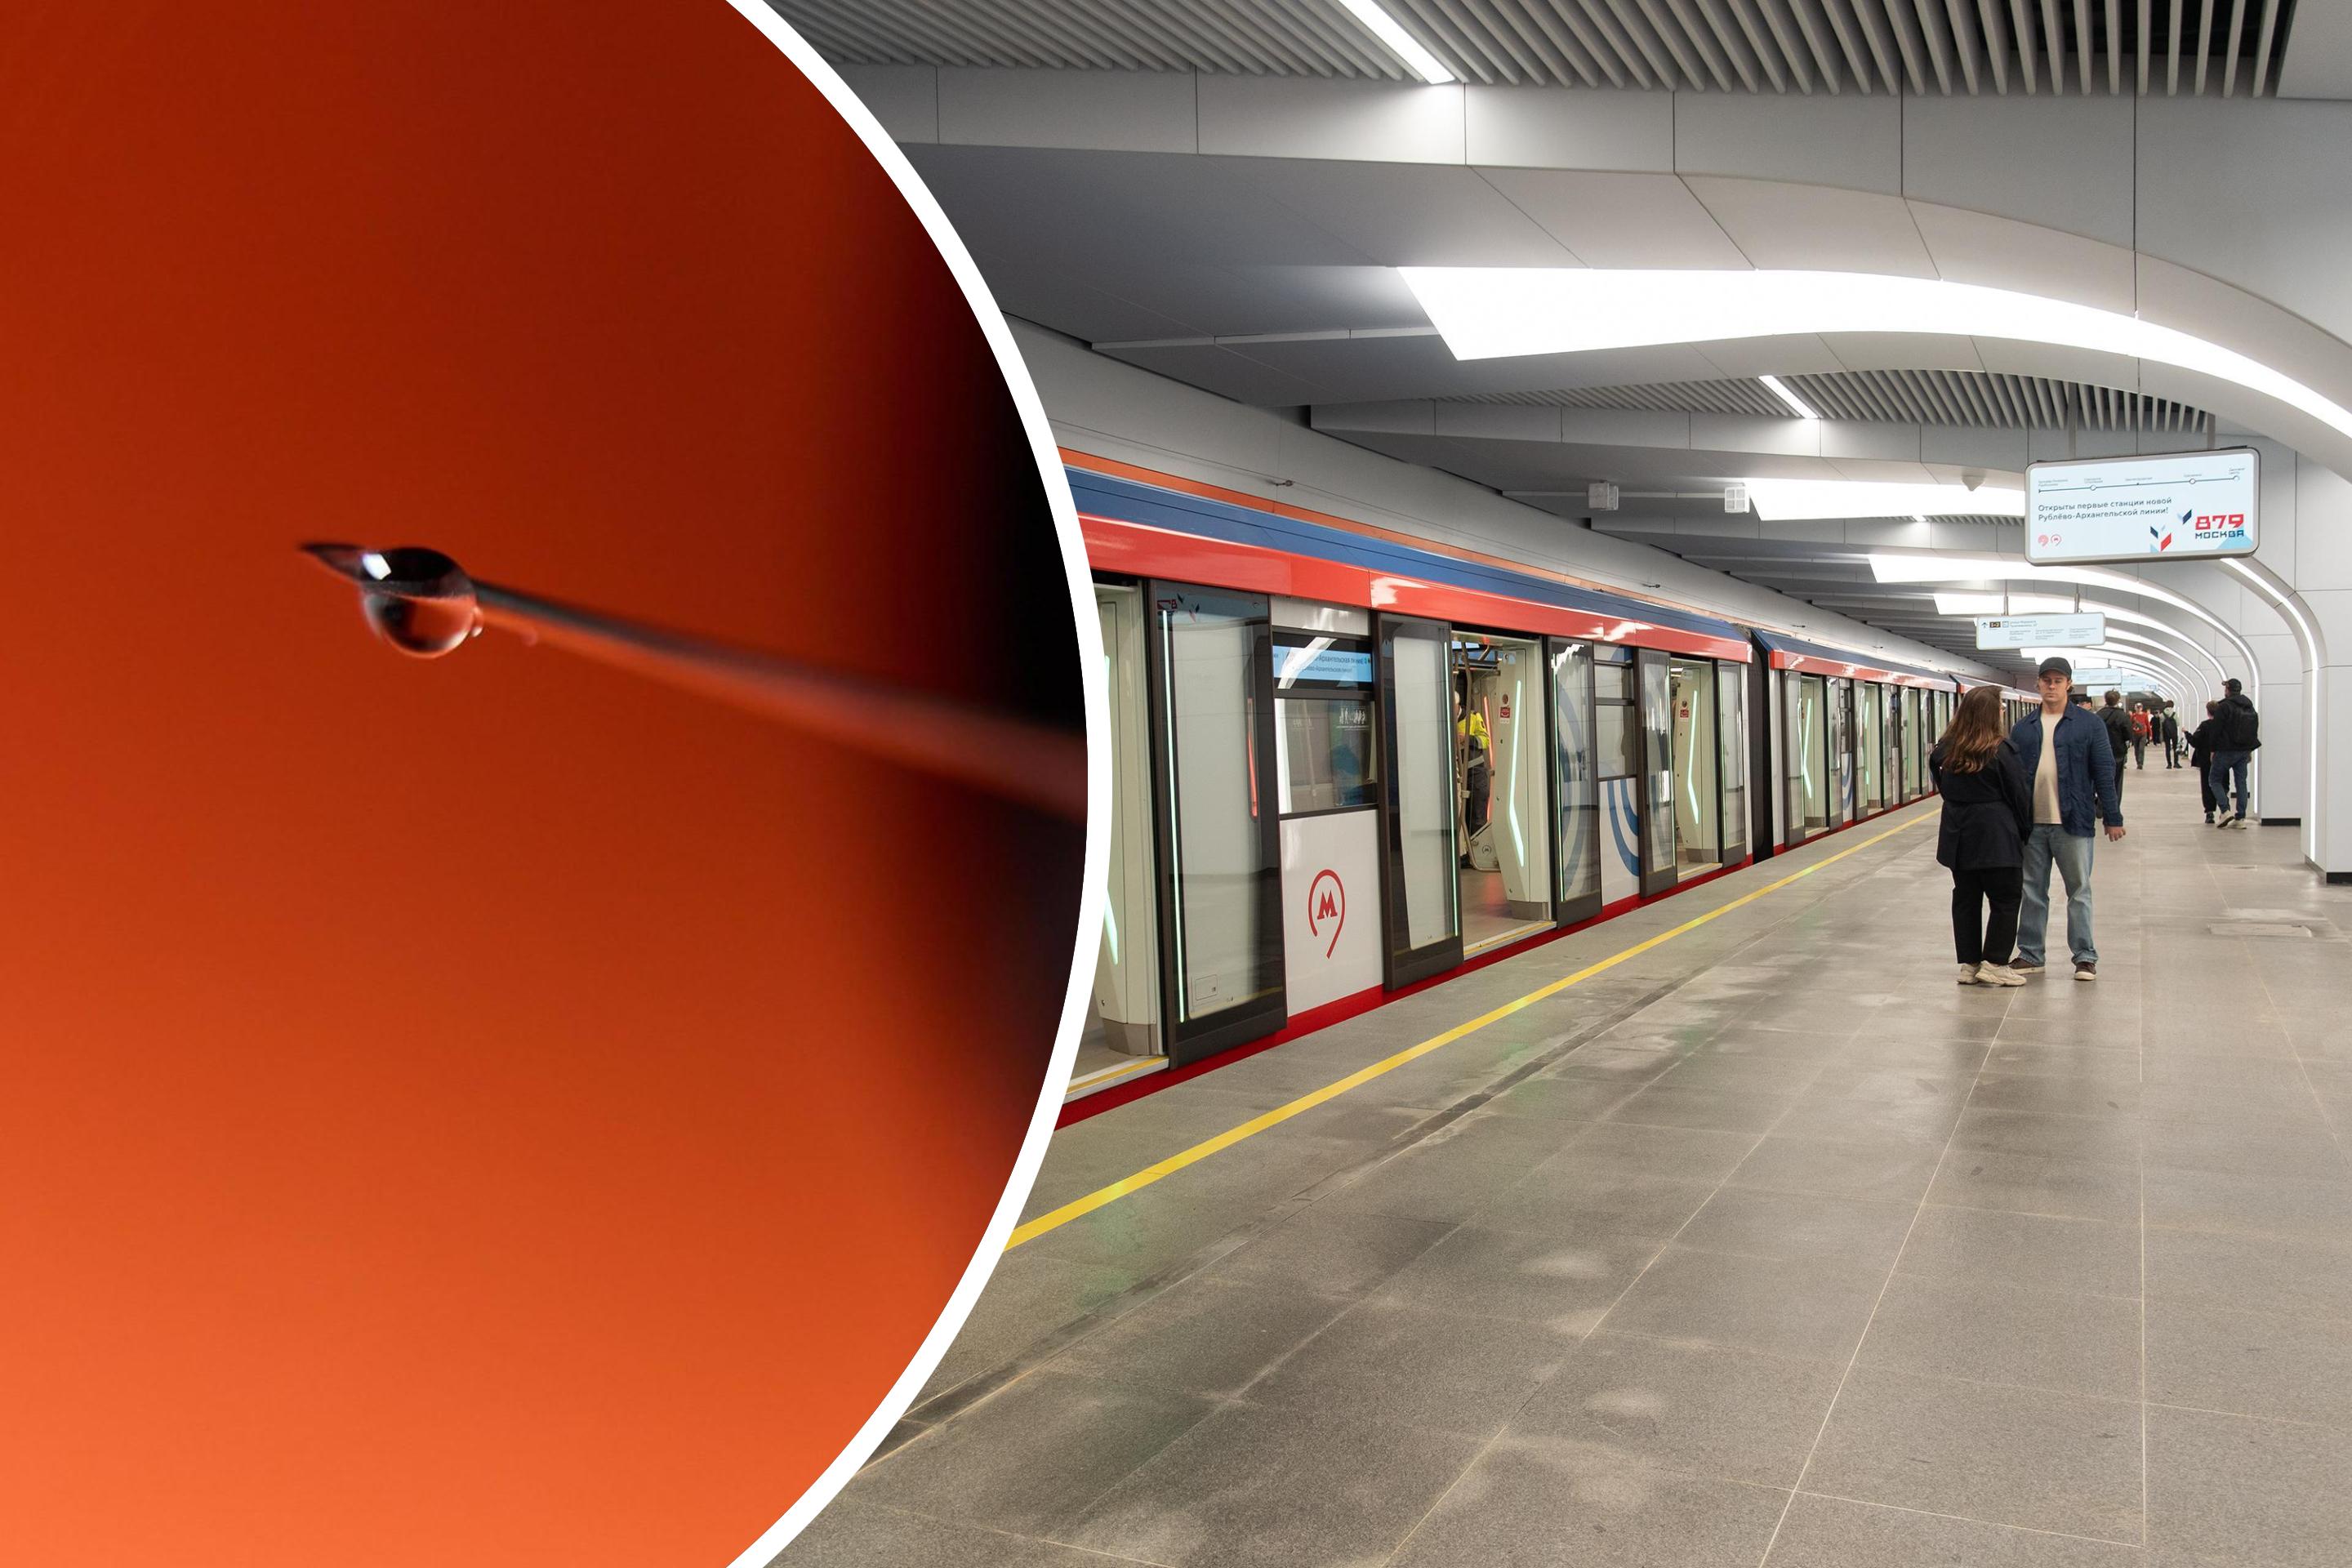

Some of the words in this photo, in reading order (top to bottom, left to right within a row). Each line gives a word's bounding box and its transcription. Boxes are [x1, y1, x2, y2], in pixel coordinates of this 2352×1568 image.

[2038, 504, 2075, 512] Открыты
[2140, 507, 2169, 515] линии!
[2195, 514, 2244, 530] 879
[2195, 529, 2244, 539] МОСКВА
[1316, 889, 1338, 920] М
